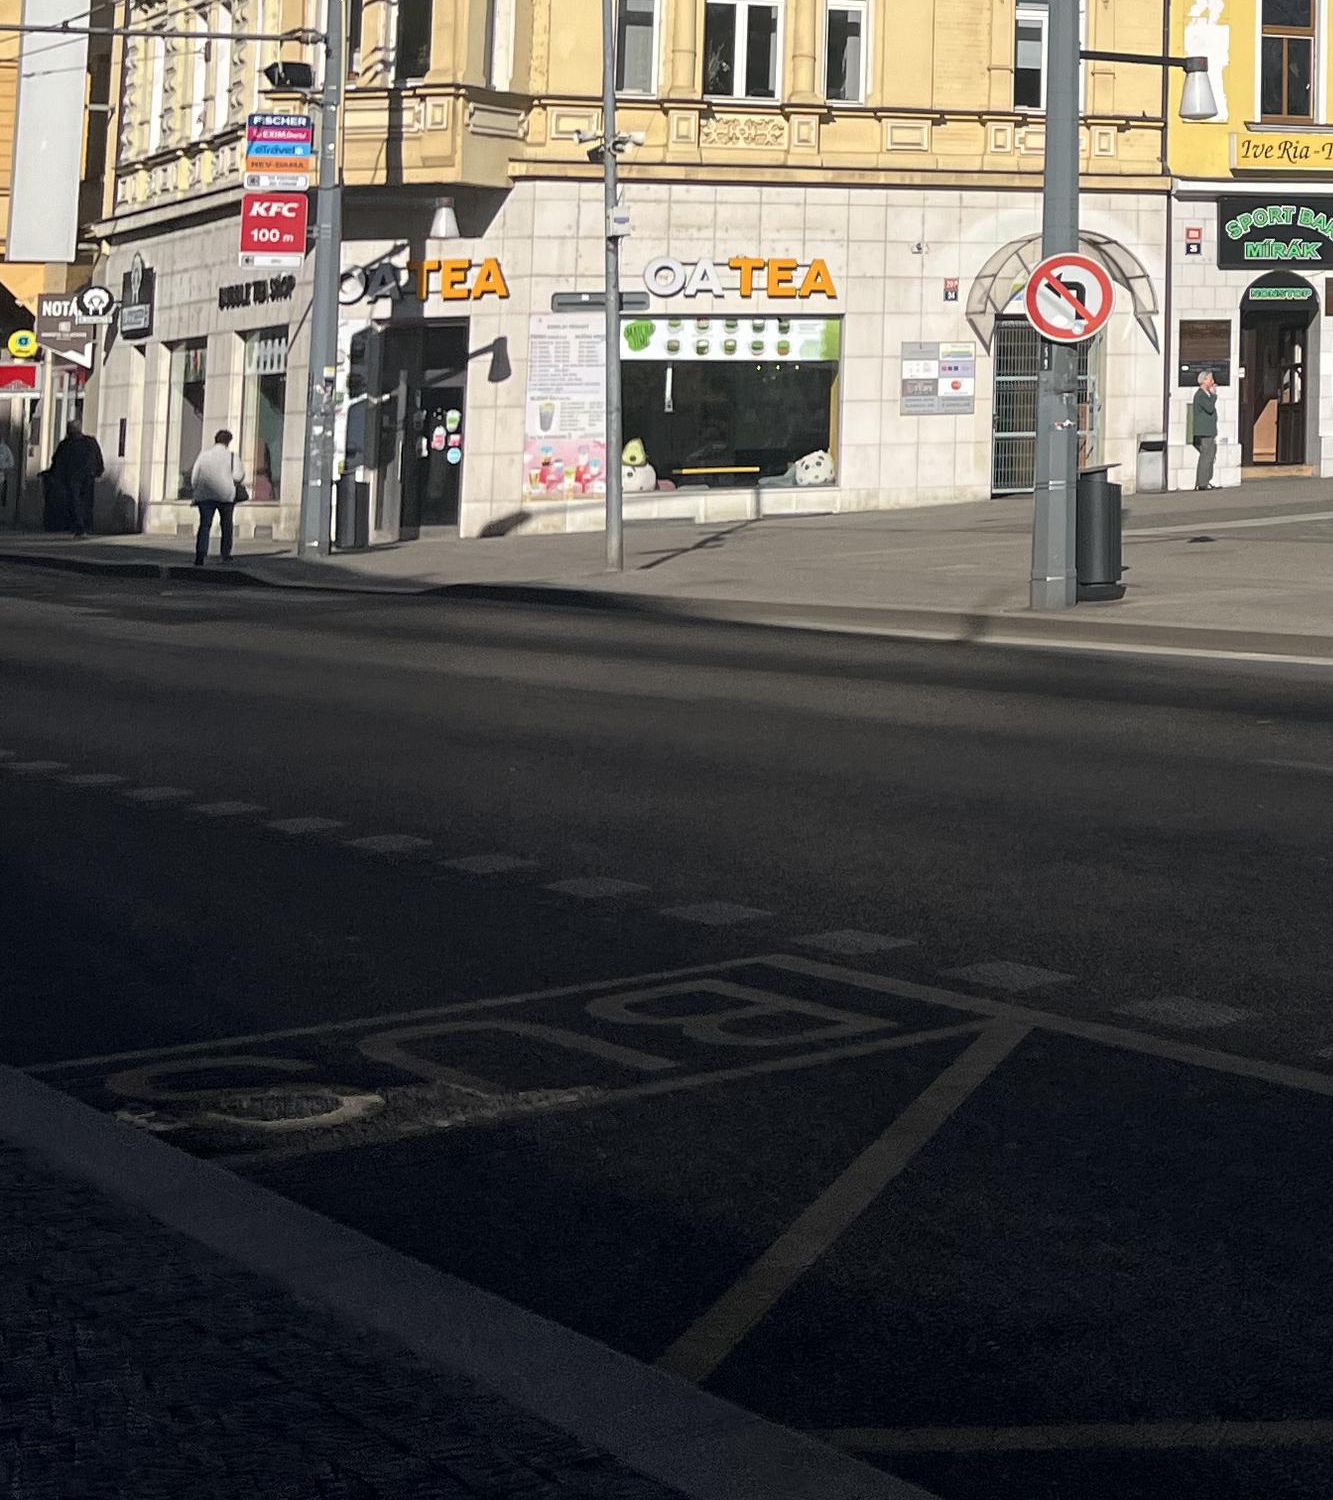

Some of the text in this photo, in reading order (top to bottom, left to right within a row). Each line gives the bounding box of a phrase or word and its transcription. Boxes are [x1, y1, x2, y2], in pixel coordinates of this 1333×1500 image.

[253, 116, 307, 126] FISCHER
[1241, 140, 1274, 159] Ive
[249, 202, 299, 218] KFC
[1225, 205, 1296, 240] SPORT
[251, 228, 294, 242] 100 m
[1244, 238, 1323, 260] MÍRÁK
[1249, 287, 1313, 300] NONSTOP
[42, 296, 83, 317] NOTÁ
